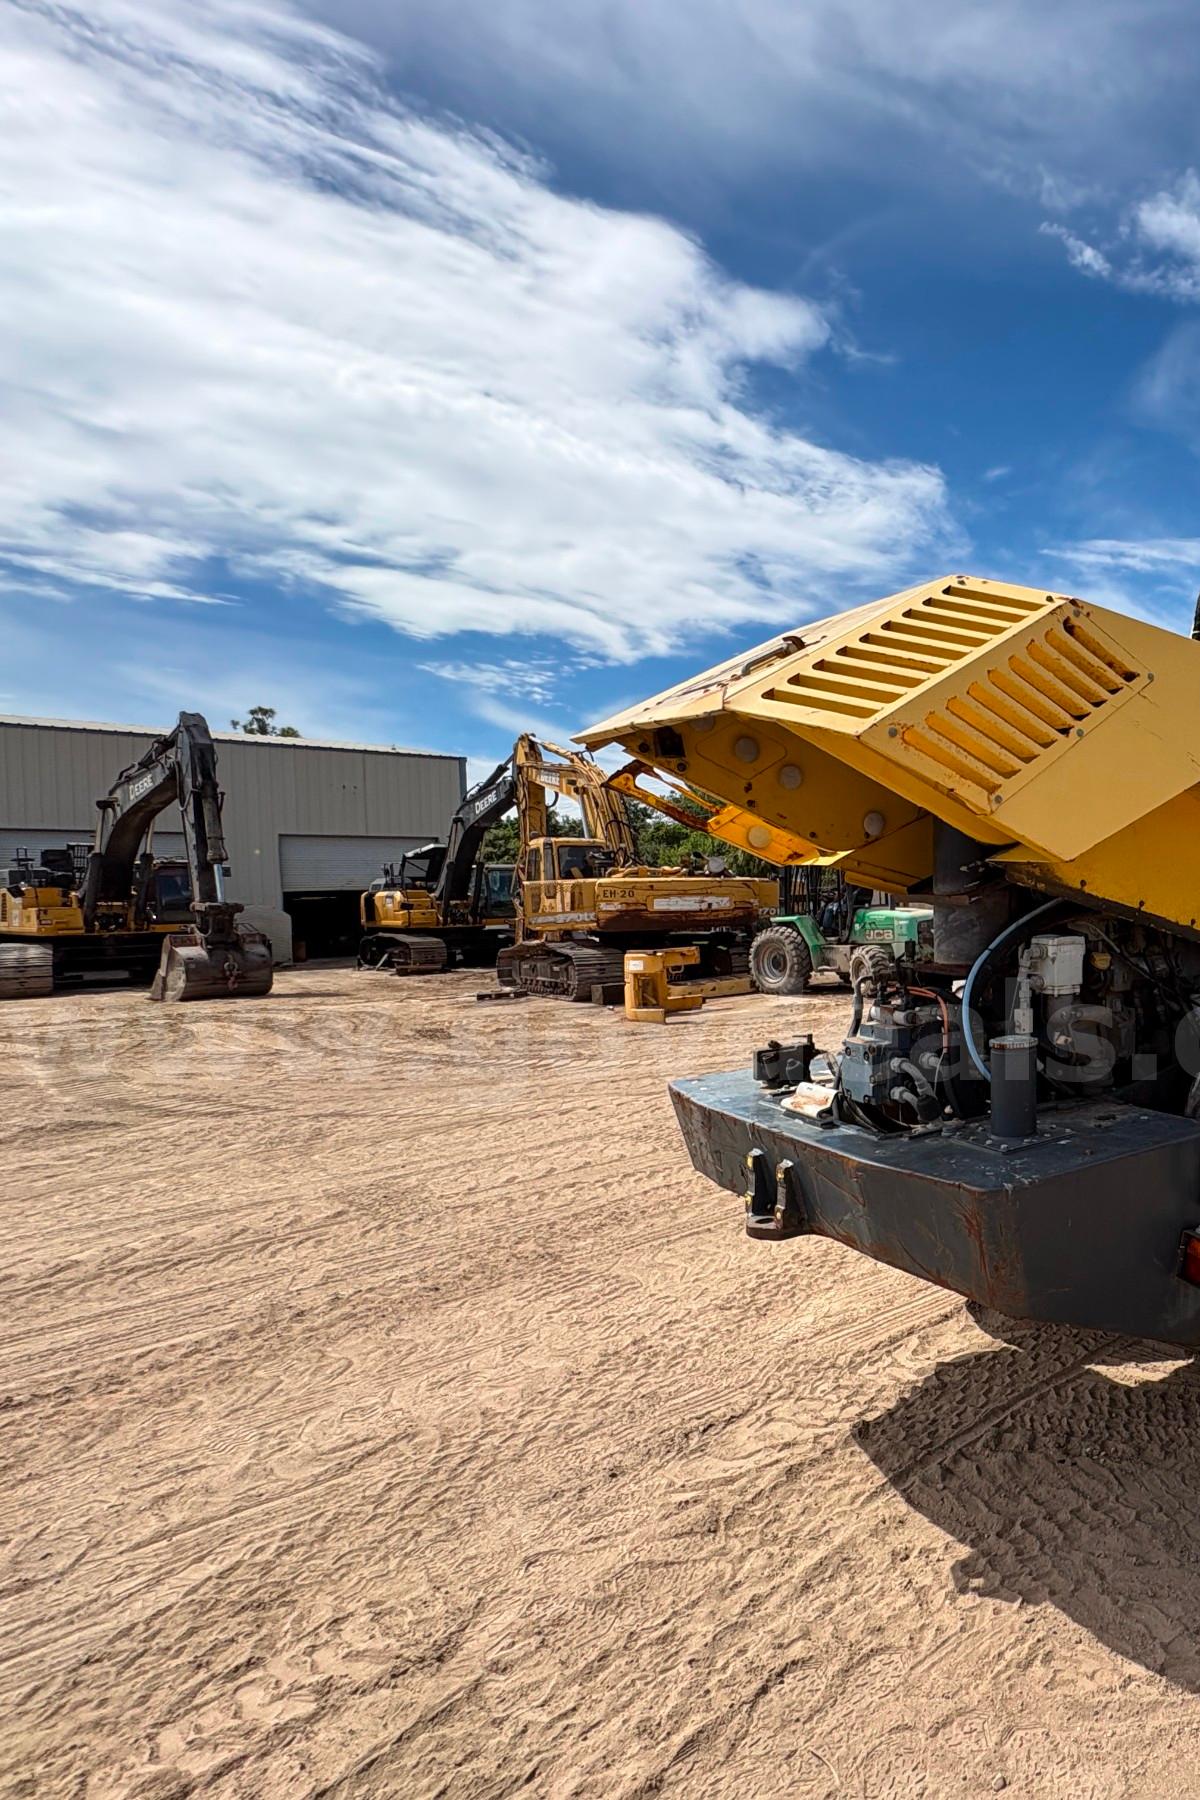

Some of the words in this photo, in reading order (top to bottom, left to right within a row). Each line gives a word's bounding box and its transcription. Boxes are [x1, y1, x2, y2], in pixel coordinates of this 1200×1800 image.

[129, 773, 154, 801] DEERE
[475, 790, 498, 815] DEERE
[865, 929, 894, 940] JCB
